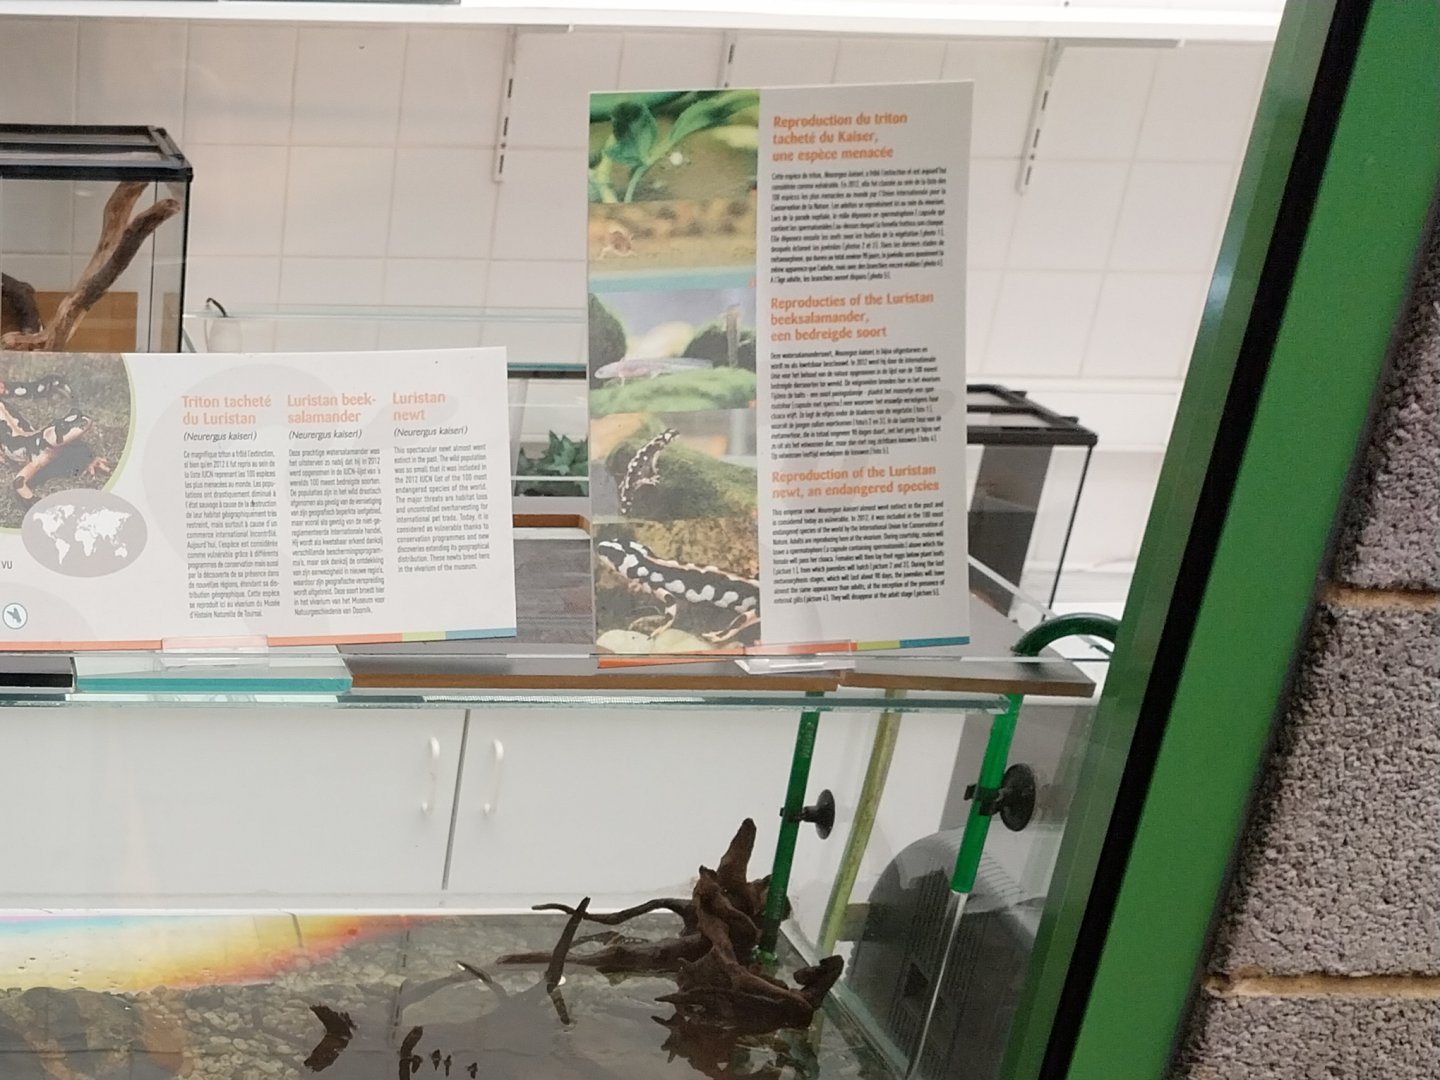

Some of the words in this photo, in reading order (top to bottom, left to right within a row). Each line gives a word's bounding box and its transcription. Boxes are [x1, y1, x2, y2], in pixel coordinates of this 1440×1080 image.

[773, 114, 851, 129] Reproduction
[856, 113, 871, 125] du
[875, 112, 907, 124] triton
[773, 132, 815, 144] tacheté
[820, 131, 833, 143] du
[838, 130, 878, 142] Kaiser,
[772, 152, 793, 161] une
[798, 149, 837, 163] espèce
[841, 147, 893, 159] menacée
[771, 296, 845, 311] Reproducties
[850, 294, 860, 305] of
[865, 294, 882, 305] the
[887, 292, 933, 304] Luristan
[771, 311, 869, 325] beeksalamander,
[771, 332, 791, 341] een
[796, 328, 852, 341] bedreigde
[857, 327, 886, 337] soort
[181, 395, 219, 408] Triton
[225, 394, 271, 407] tacheté
[288, 394, 337, 407] Luristan
[342, 393, 376, 405] beek-
[392, 392, 445, 404] Luristan
[183, 411, 198, 425] du
[203, 412, 256, 424] Luristan
[288, 410, 360, 423] salamander
[394, 410, 424, 420] newt
[184, 432, 226, 442] (Neurergus
[229, 431, 257, 440] kaiseri)
[289, 431, 331, 440] (Neurergus
[334, 429, 362, 438] kaiseri)
[394, 428, 436, 437] (Neurergus
[439, 426, 468, 435] kaiseri)
[772, 469, 848, 484] Reproduction
[853, 467, 863, 478] of
[868, 466, 885, 477] the
[890, 465, 936, 476] Luristan
[772, 487, 803, 498] newt,
[808, 488, 821, 497] an
[826, 482, 893, 497] endangered
[898, 481, 939, 494] species
